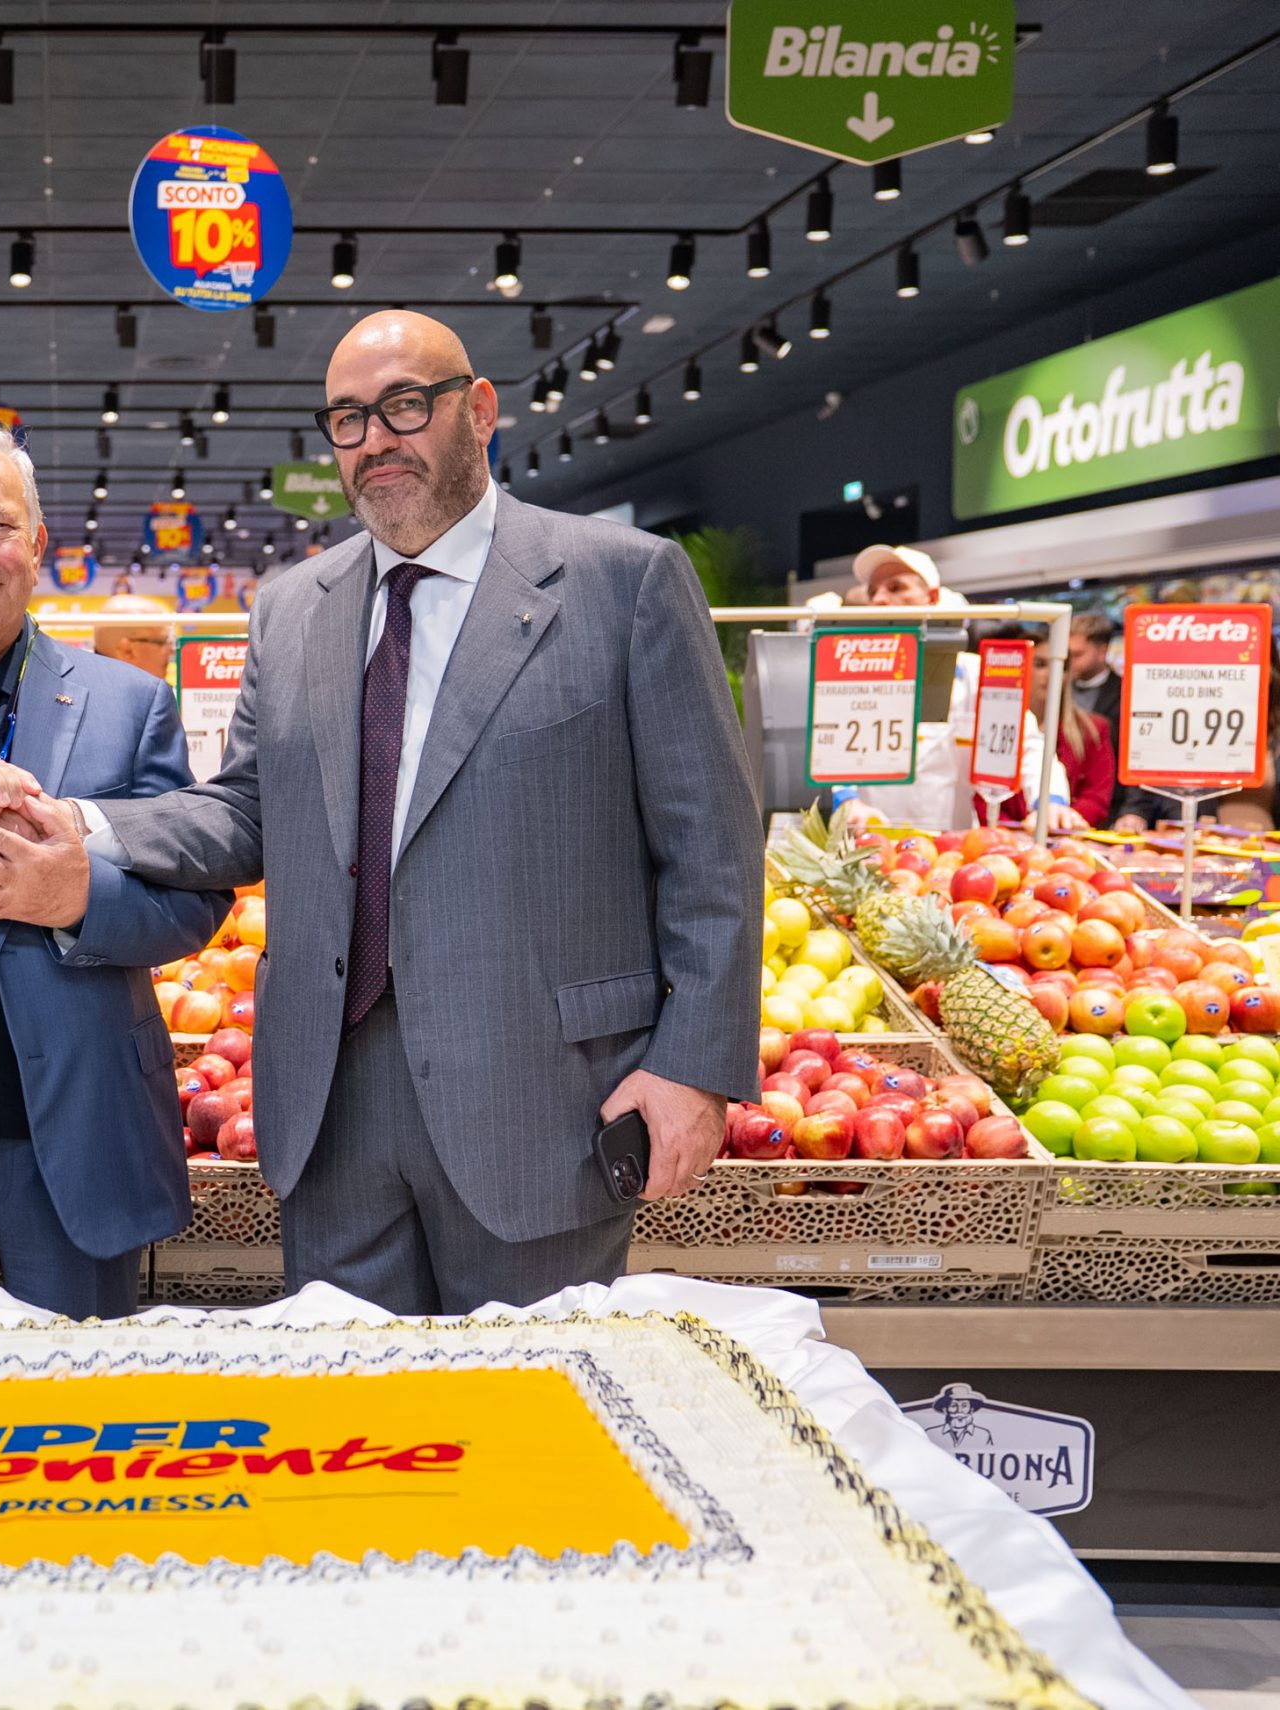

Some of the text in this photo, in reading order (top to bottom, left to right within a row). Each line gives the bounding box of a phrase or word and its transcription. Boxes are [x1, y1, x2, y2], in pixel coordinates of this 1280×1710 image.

[763, 24, 981, 78] Bilancia
[165, 186, 238, 203] SCONTO
[172, 209, 256, 263] 10%
[1004, 350, 1244, 479] Ortofrutta
[1145, 615, 1249, 642] offerta
[200, 645, 248, 666] prez
[834, 635, 900, 659] prezzi
[839, 652, 896, 672] fermi
[1146, 669, 1246, 681] TERRABUONA MELE
[1166, 686, 1224, 698] GOLD BINS
[845, 719, 903, 754] 2,15
[1138, 708, 1245, 749] 67 0,99
